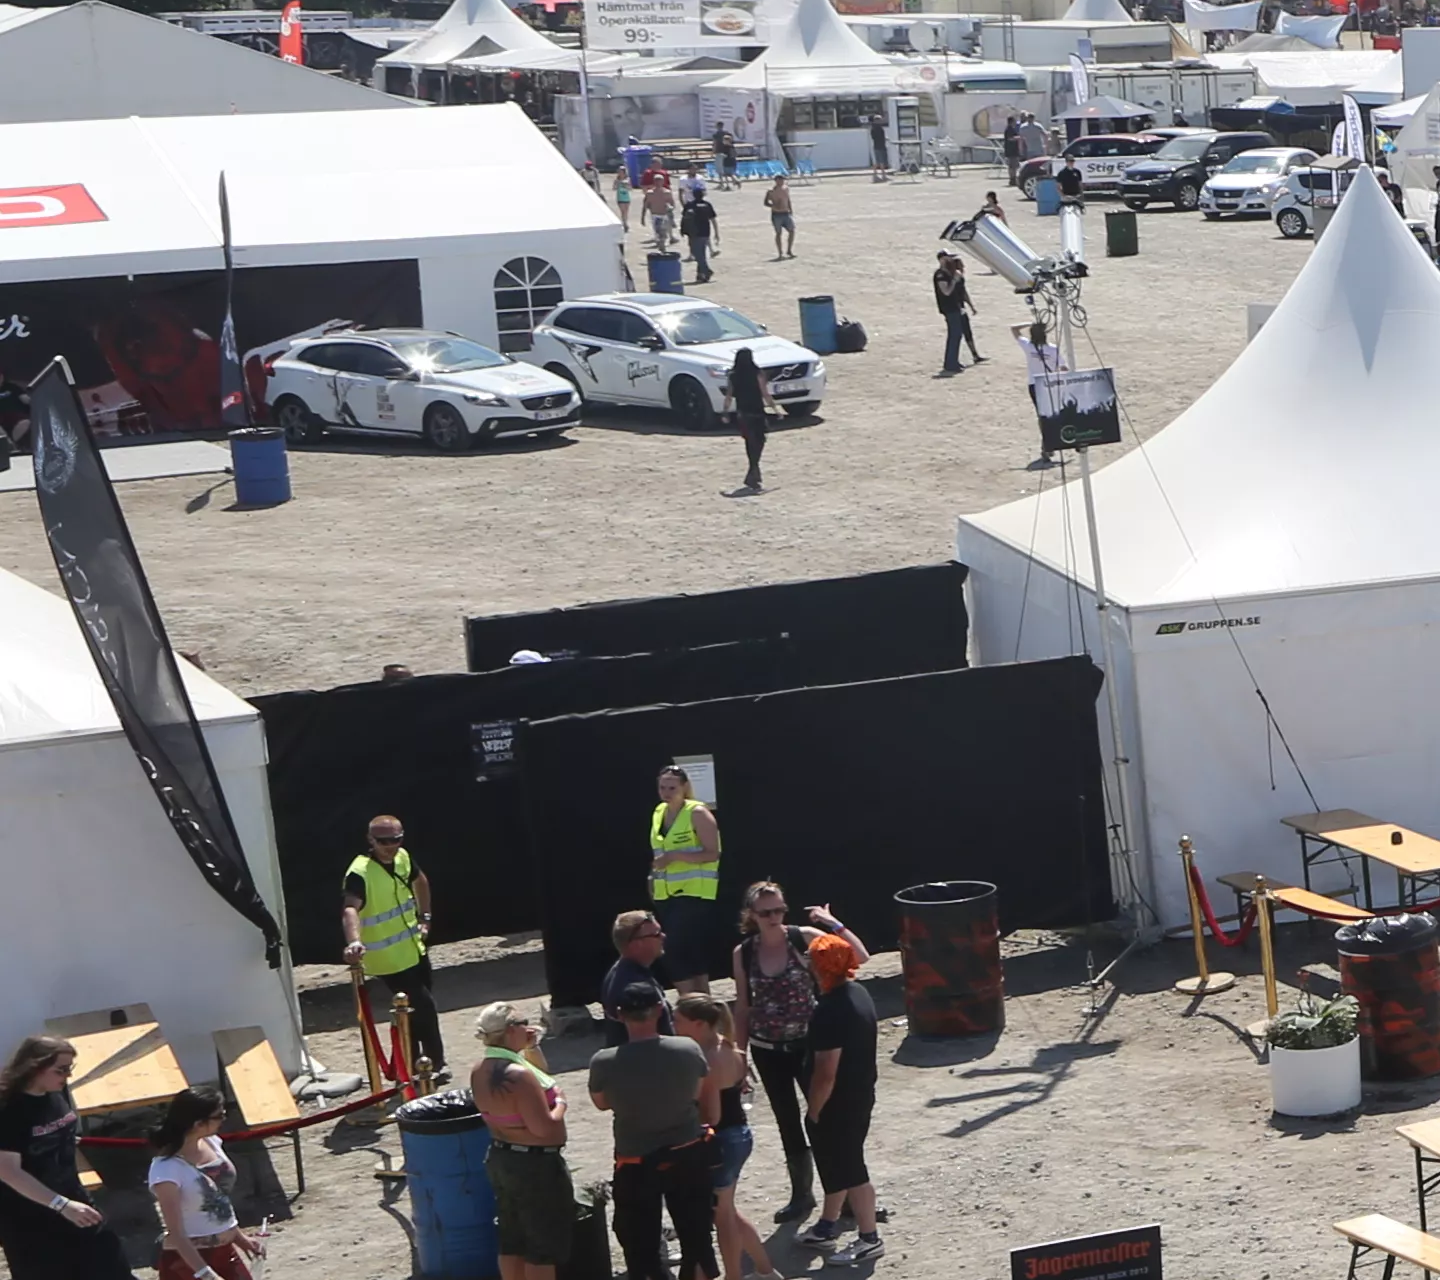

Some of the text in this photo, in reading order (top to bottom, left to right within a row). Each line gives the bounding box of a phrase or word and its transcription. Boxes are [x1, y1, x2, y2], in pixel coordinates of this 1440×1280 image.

[597, 1, 684, 12] Hämtmat från
[598, 14, 685, 27] Operakällaren
[624, 28, 663, 43] 99:-
[1086, 161, 1115, 175] Stig
[1066, 375, 1096, 386] provided
[1188, 617, 1262, 631] GRUPPEN.SE
